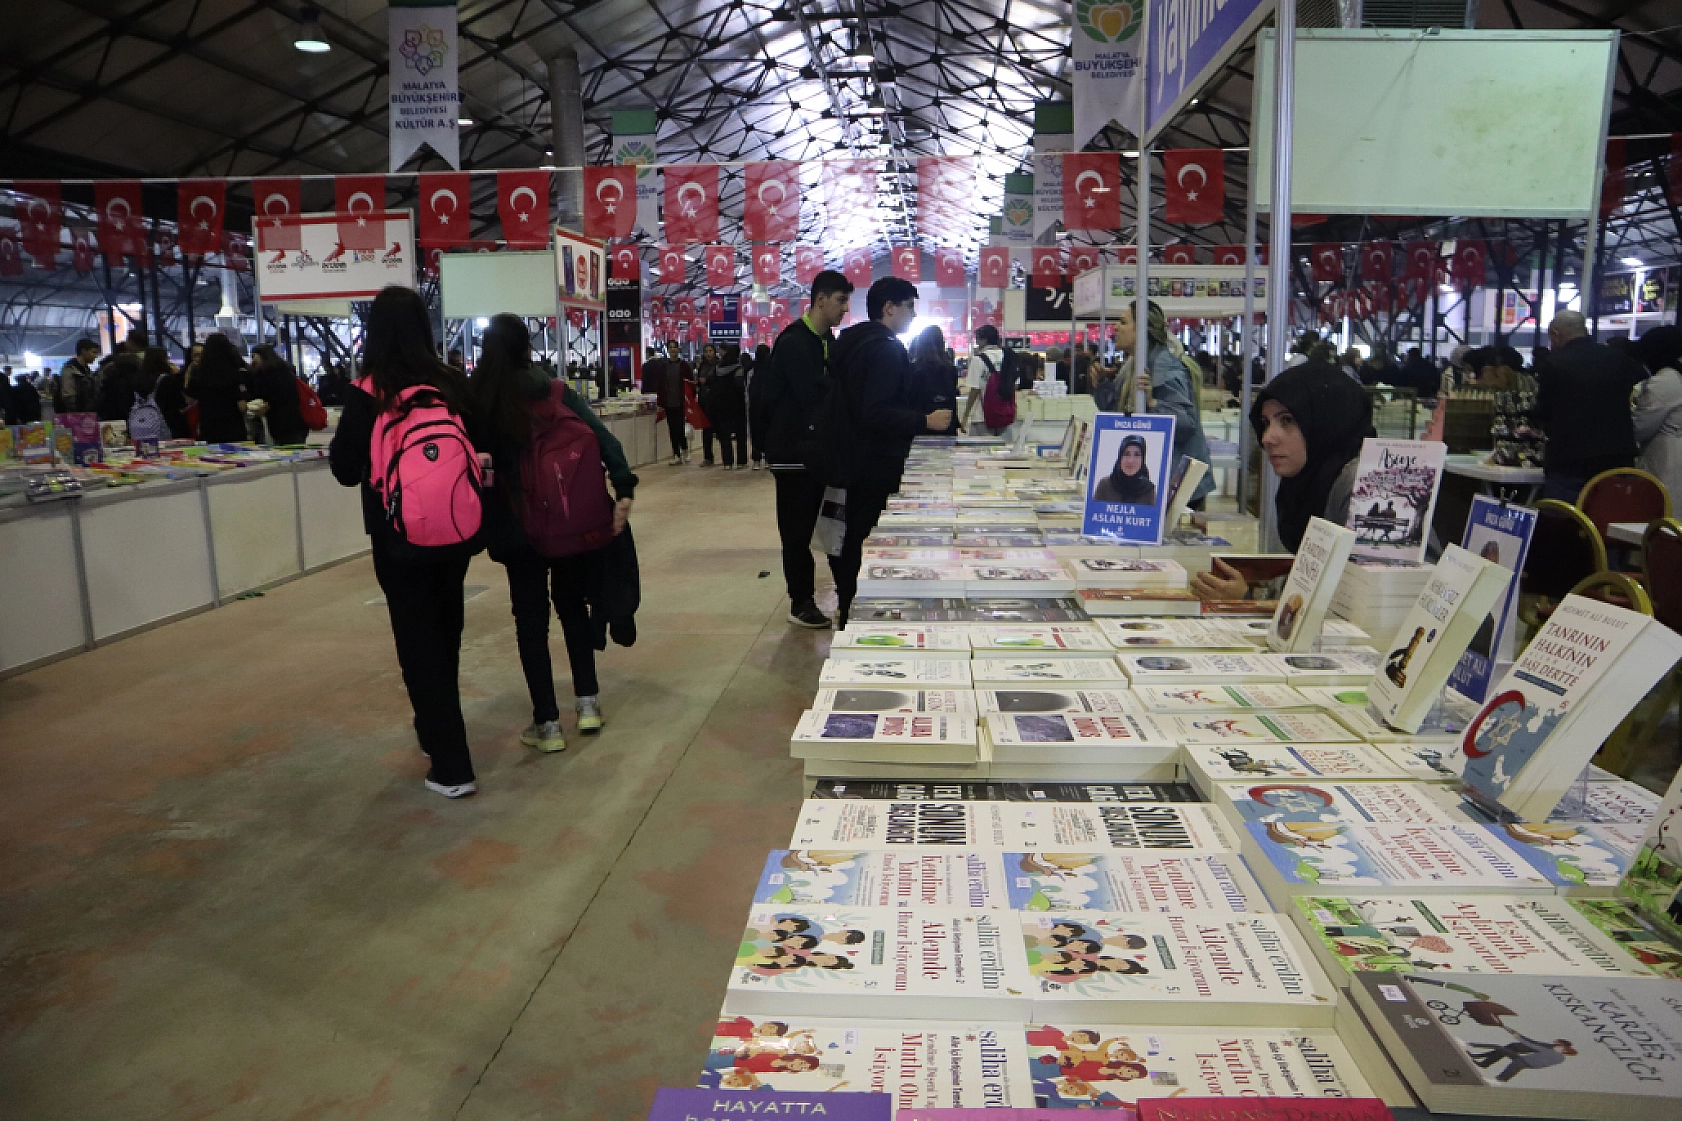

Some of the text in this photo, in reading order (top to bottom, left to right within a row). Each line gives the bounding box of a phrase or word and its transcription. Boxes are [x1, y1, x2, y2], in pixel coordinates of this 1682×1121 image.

[391, 91, 458, 105] BÜYÜKŞEHİR
[402, 81, 447, 91] MALATYA
[395, 118, 434, 130] KÜLTÜR
[1091, 513, 1152, 527] ASLAN KURT
[1106, 504, 1136, 515] NEJLA
[1546, 621, 1611, 653] TANRININ
[1537, 663, 1581, 687] DERTTE
[917, 803, 967, 846] SONUN
[1128, 806, 1194, 849] SONUN
[892, 911, 919, 991] Huzur İstiyorum
[921, 919, 949, 981] Ailemde
[978, 914, 1006, 990] saliha erdim
[1168, 915, 1213, 998] Huzur İstiyorum
[1196, 924, 1245, 986] Ailemde
[1249, 918, 1305, 995] saliha erdim
[1439, 915, 1513, 972] İstiyorum
[1529, 901, 1574, 934] saliha
[1564, 937, 1621, 972] erdim
[1540, 982, 1663, 1083] KISKANÇLIĞI
[1591, 999, 1675, 1061] KARDEŞ
[868, 1047, 897, 1093] İstiyor
[898, 1032, 922, 1110] Mutlu Olm
[979, 1030, 1012, 1108] saliha erd
[1195, 1052, 1227, 1097] İstiyor
[1217, 1038, 1254, 1086] Mutlu
[1295, 1036, 1335, 1083] saliha
[711, 1098, 827, 1116] HAYATTA
[1258, 1072, 1278, 1097] Düşen
